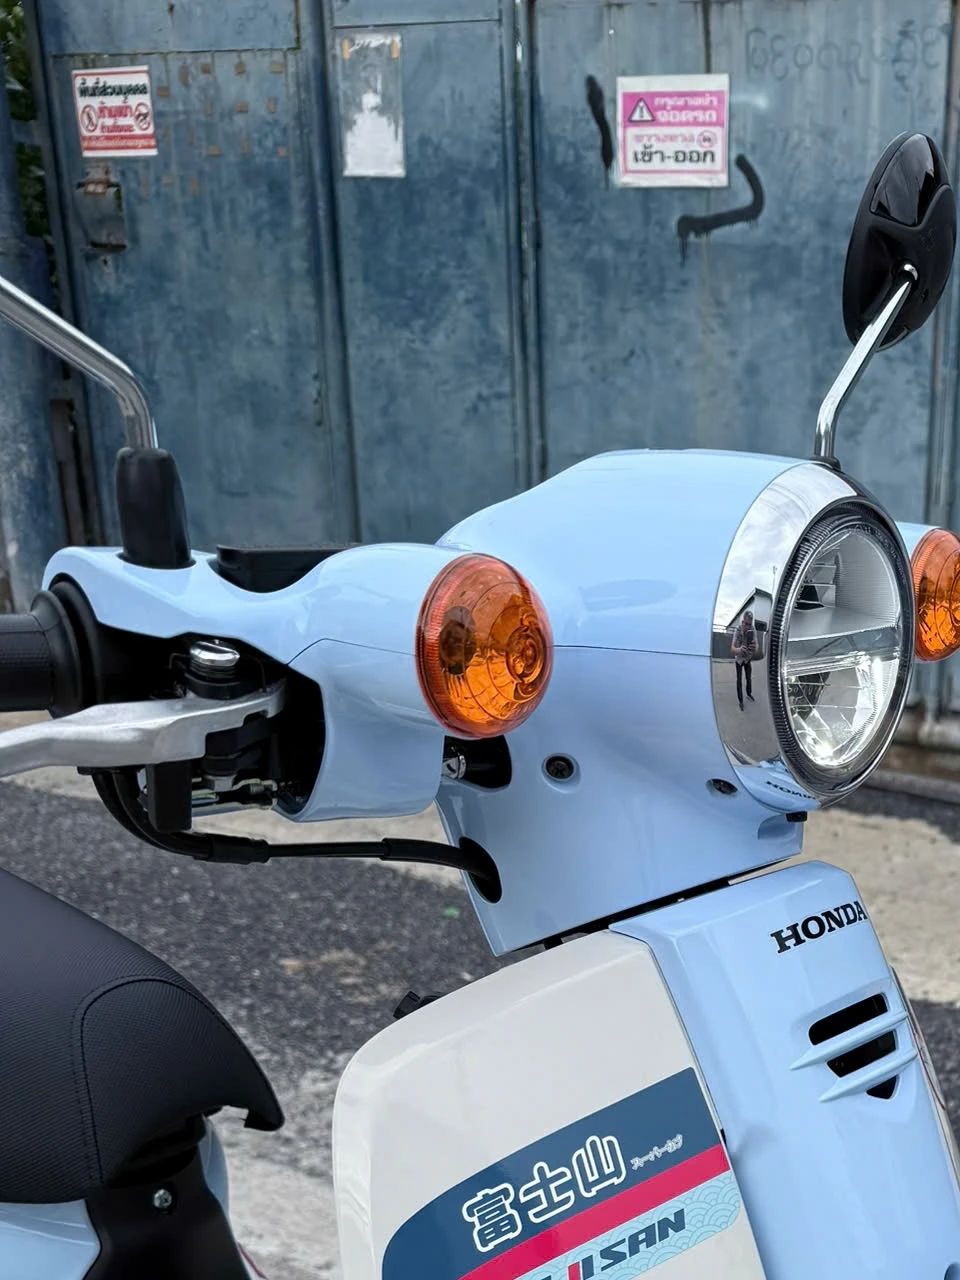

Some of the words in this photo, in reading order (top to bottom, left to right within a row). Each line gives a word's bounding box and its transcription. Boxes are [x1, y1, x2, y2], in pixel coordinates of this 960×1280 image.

[633, 144, 716, 164] เข้า-ออก
[770, 900, 869, 954] HONDA
[461, 1134, 627, 1254] 富士山
